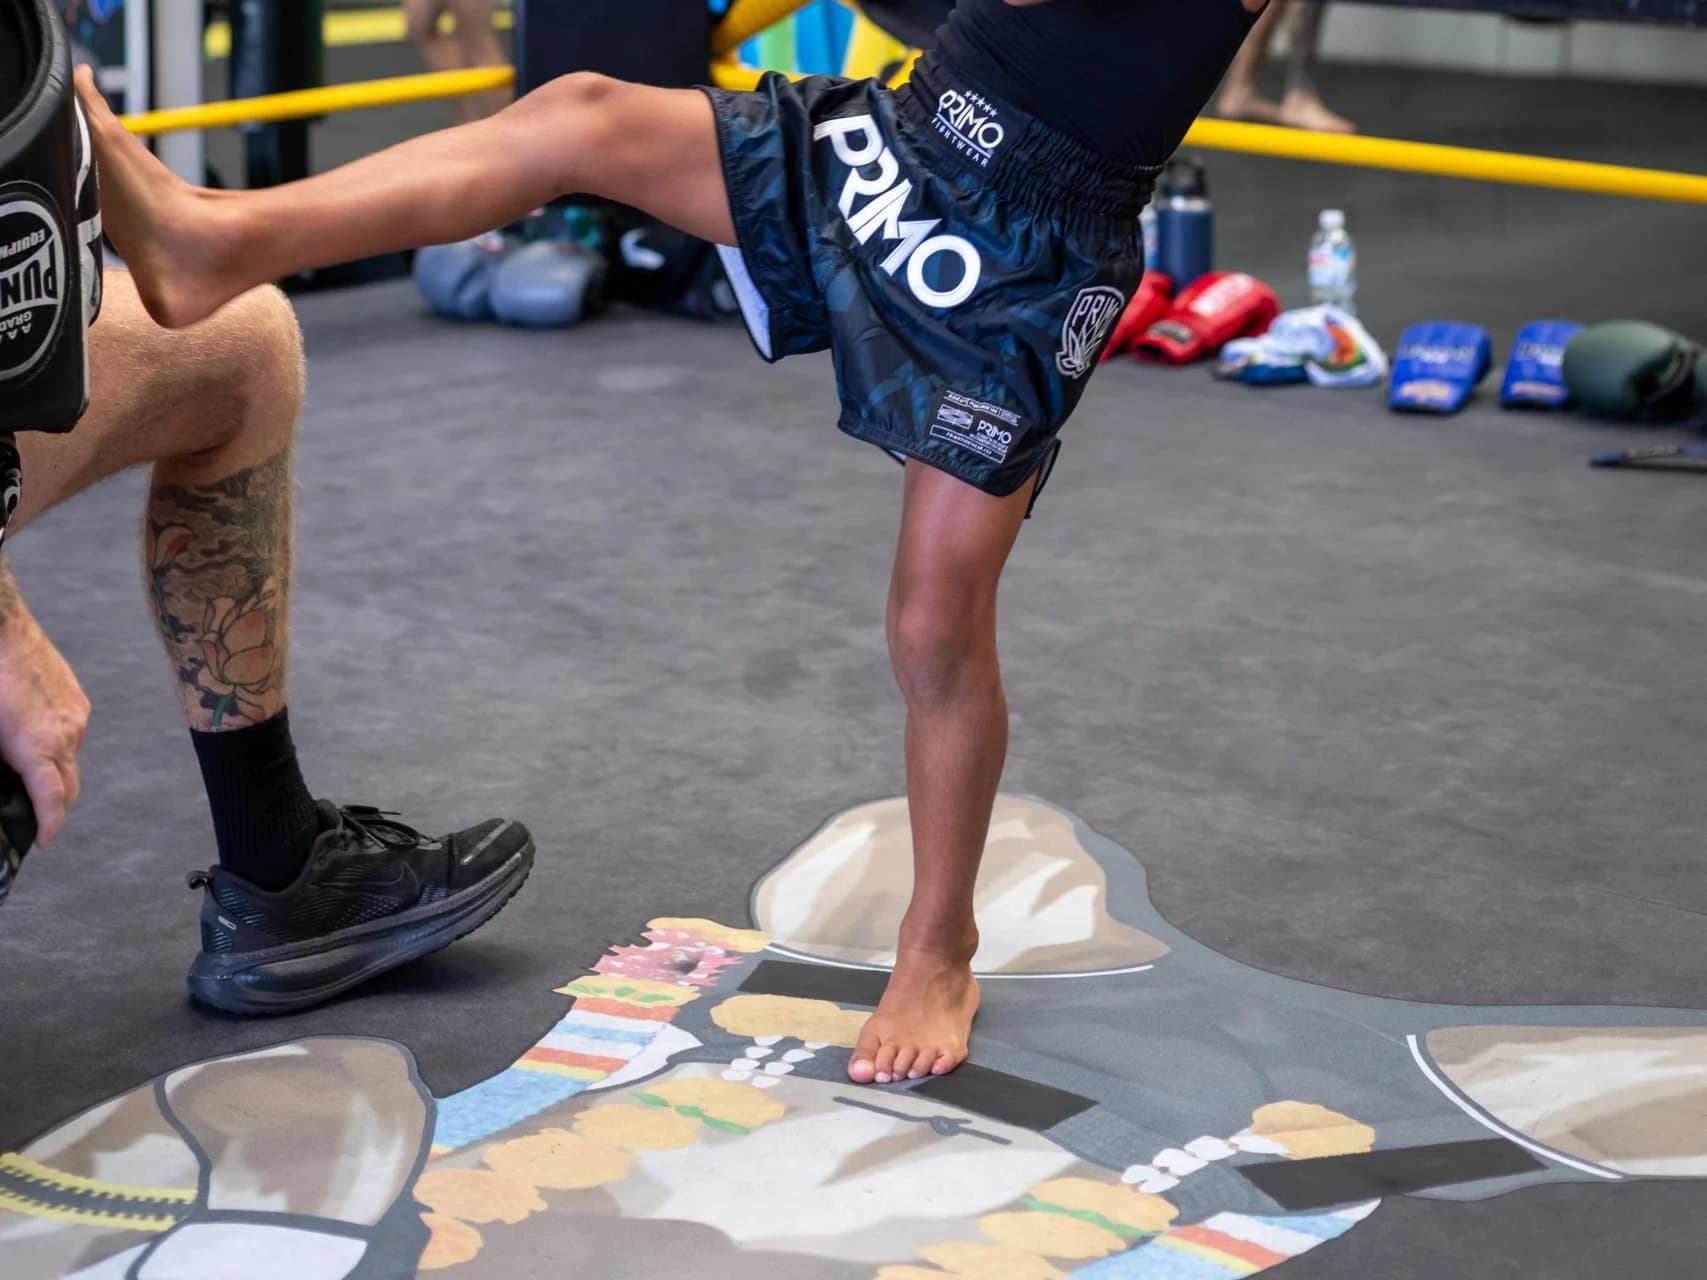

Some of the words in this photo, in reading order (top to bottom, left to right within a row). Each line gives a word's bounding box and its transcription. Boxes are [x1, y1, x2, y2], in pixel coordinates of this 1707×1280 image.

[937, 89, 1004, 149] PRIMO
[813, 114, 981, 308] PRIMO
[977, 419, 1012, 444] PRIMO
